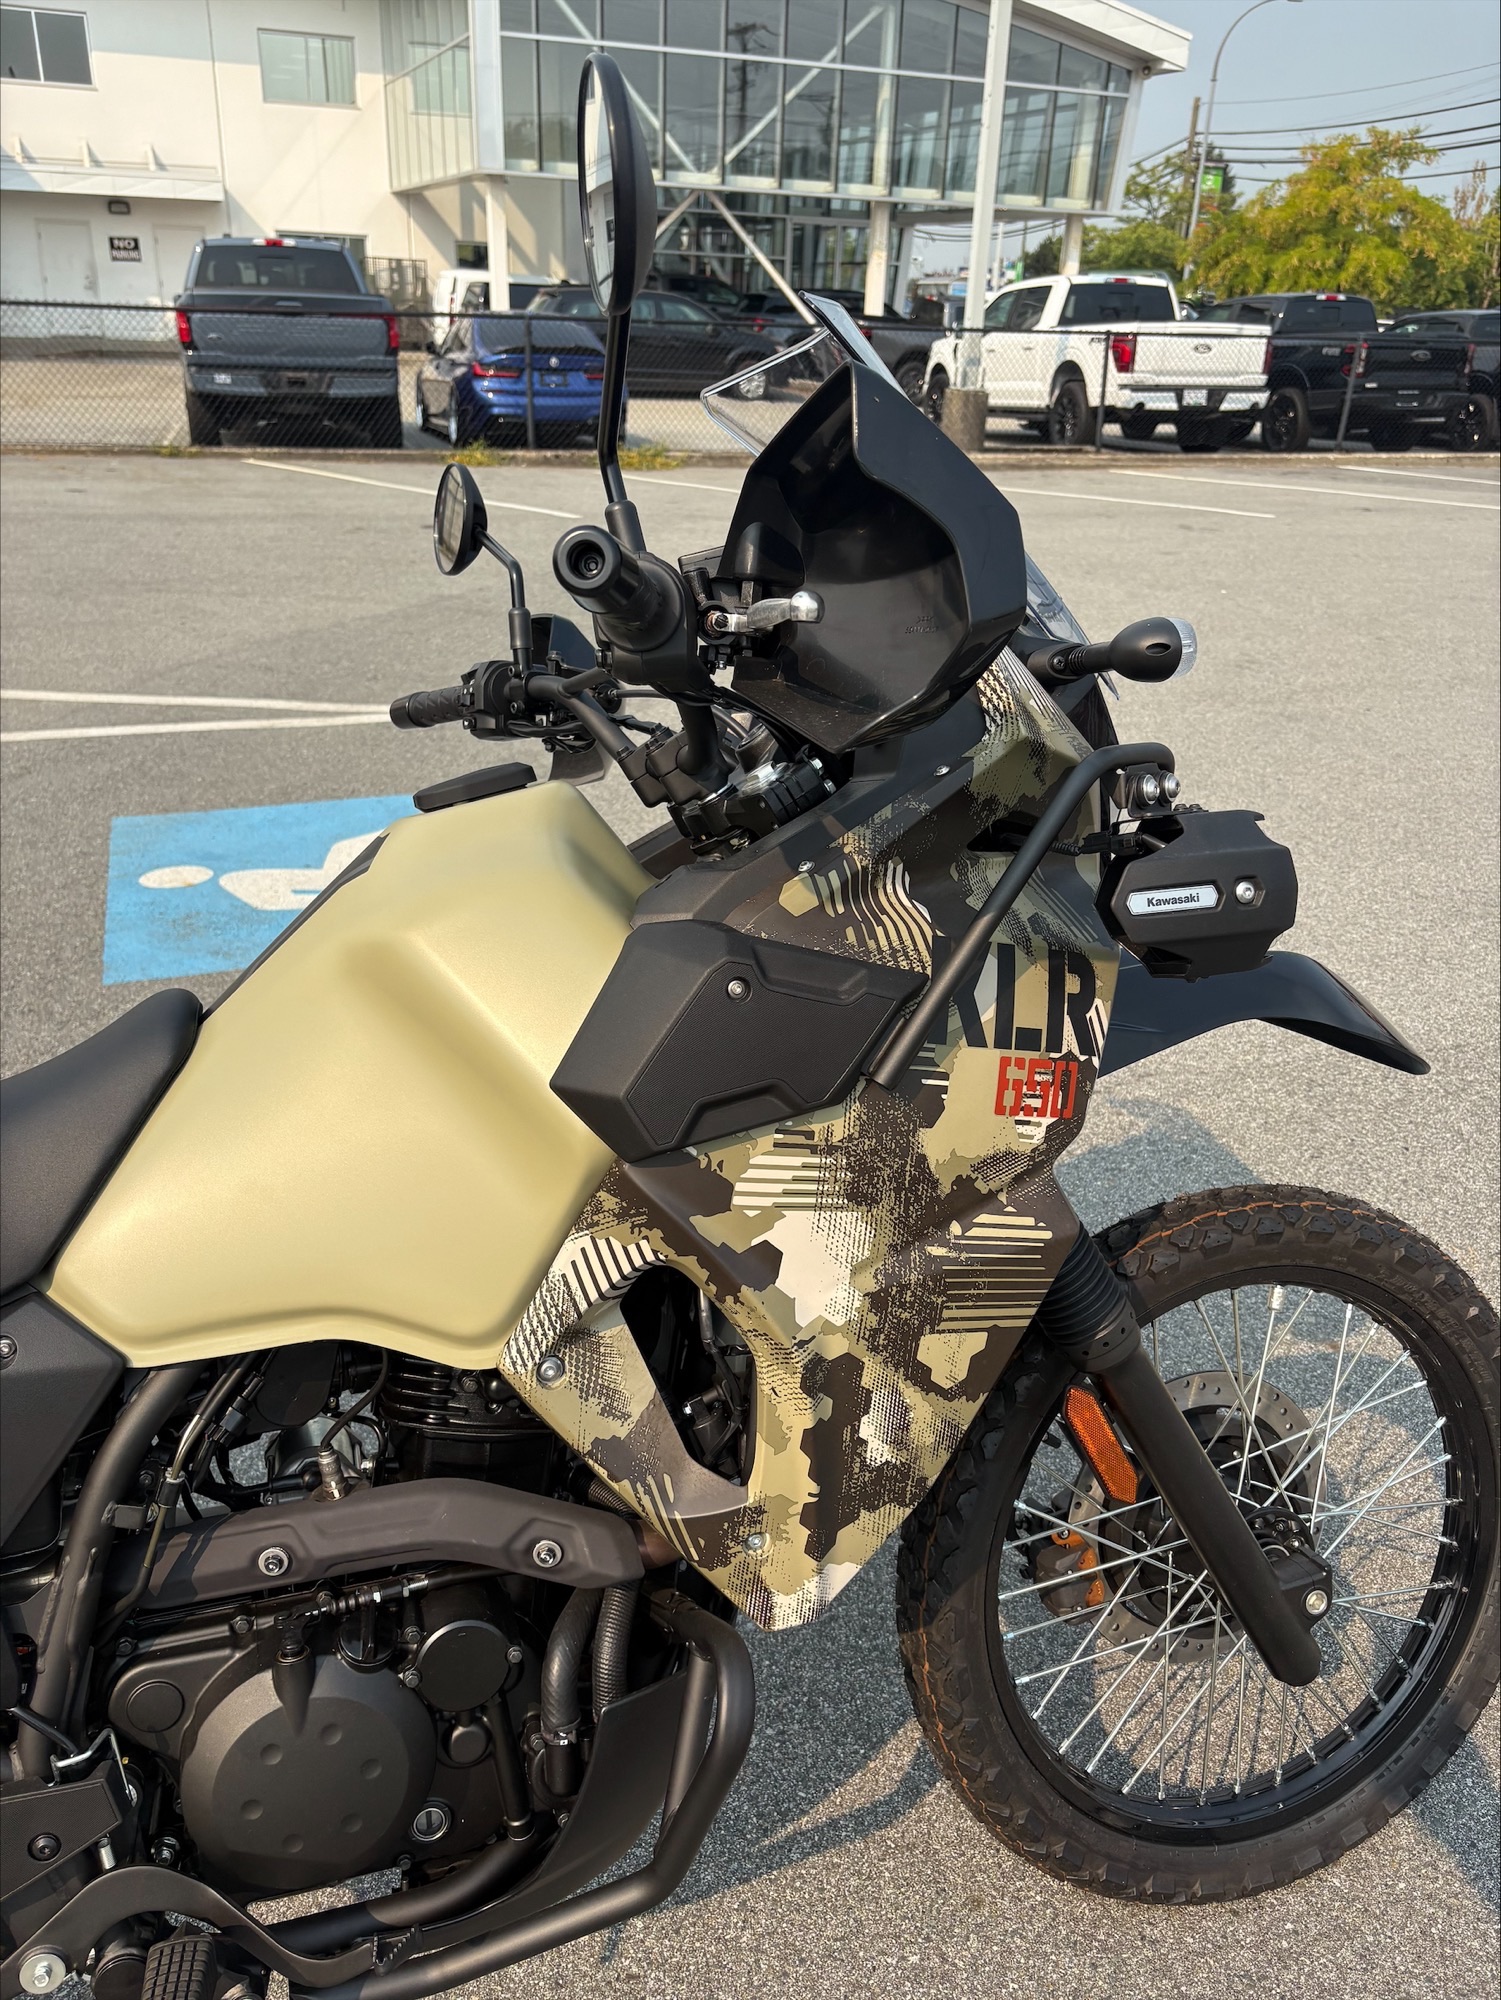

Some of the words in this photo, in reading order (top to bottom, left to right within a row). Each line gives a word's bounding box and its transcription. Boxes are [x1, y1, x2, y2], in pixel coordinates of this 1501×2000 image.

[112, 238, 136, 250] NO
[1146, 893, 1200, 907] Kawasaki
[927, 935, 1096, 1056] KLR
[994, 1056, 1078, 1119] 650
